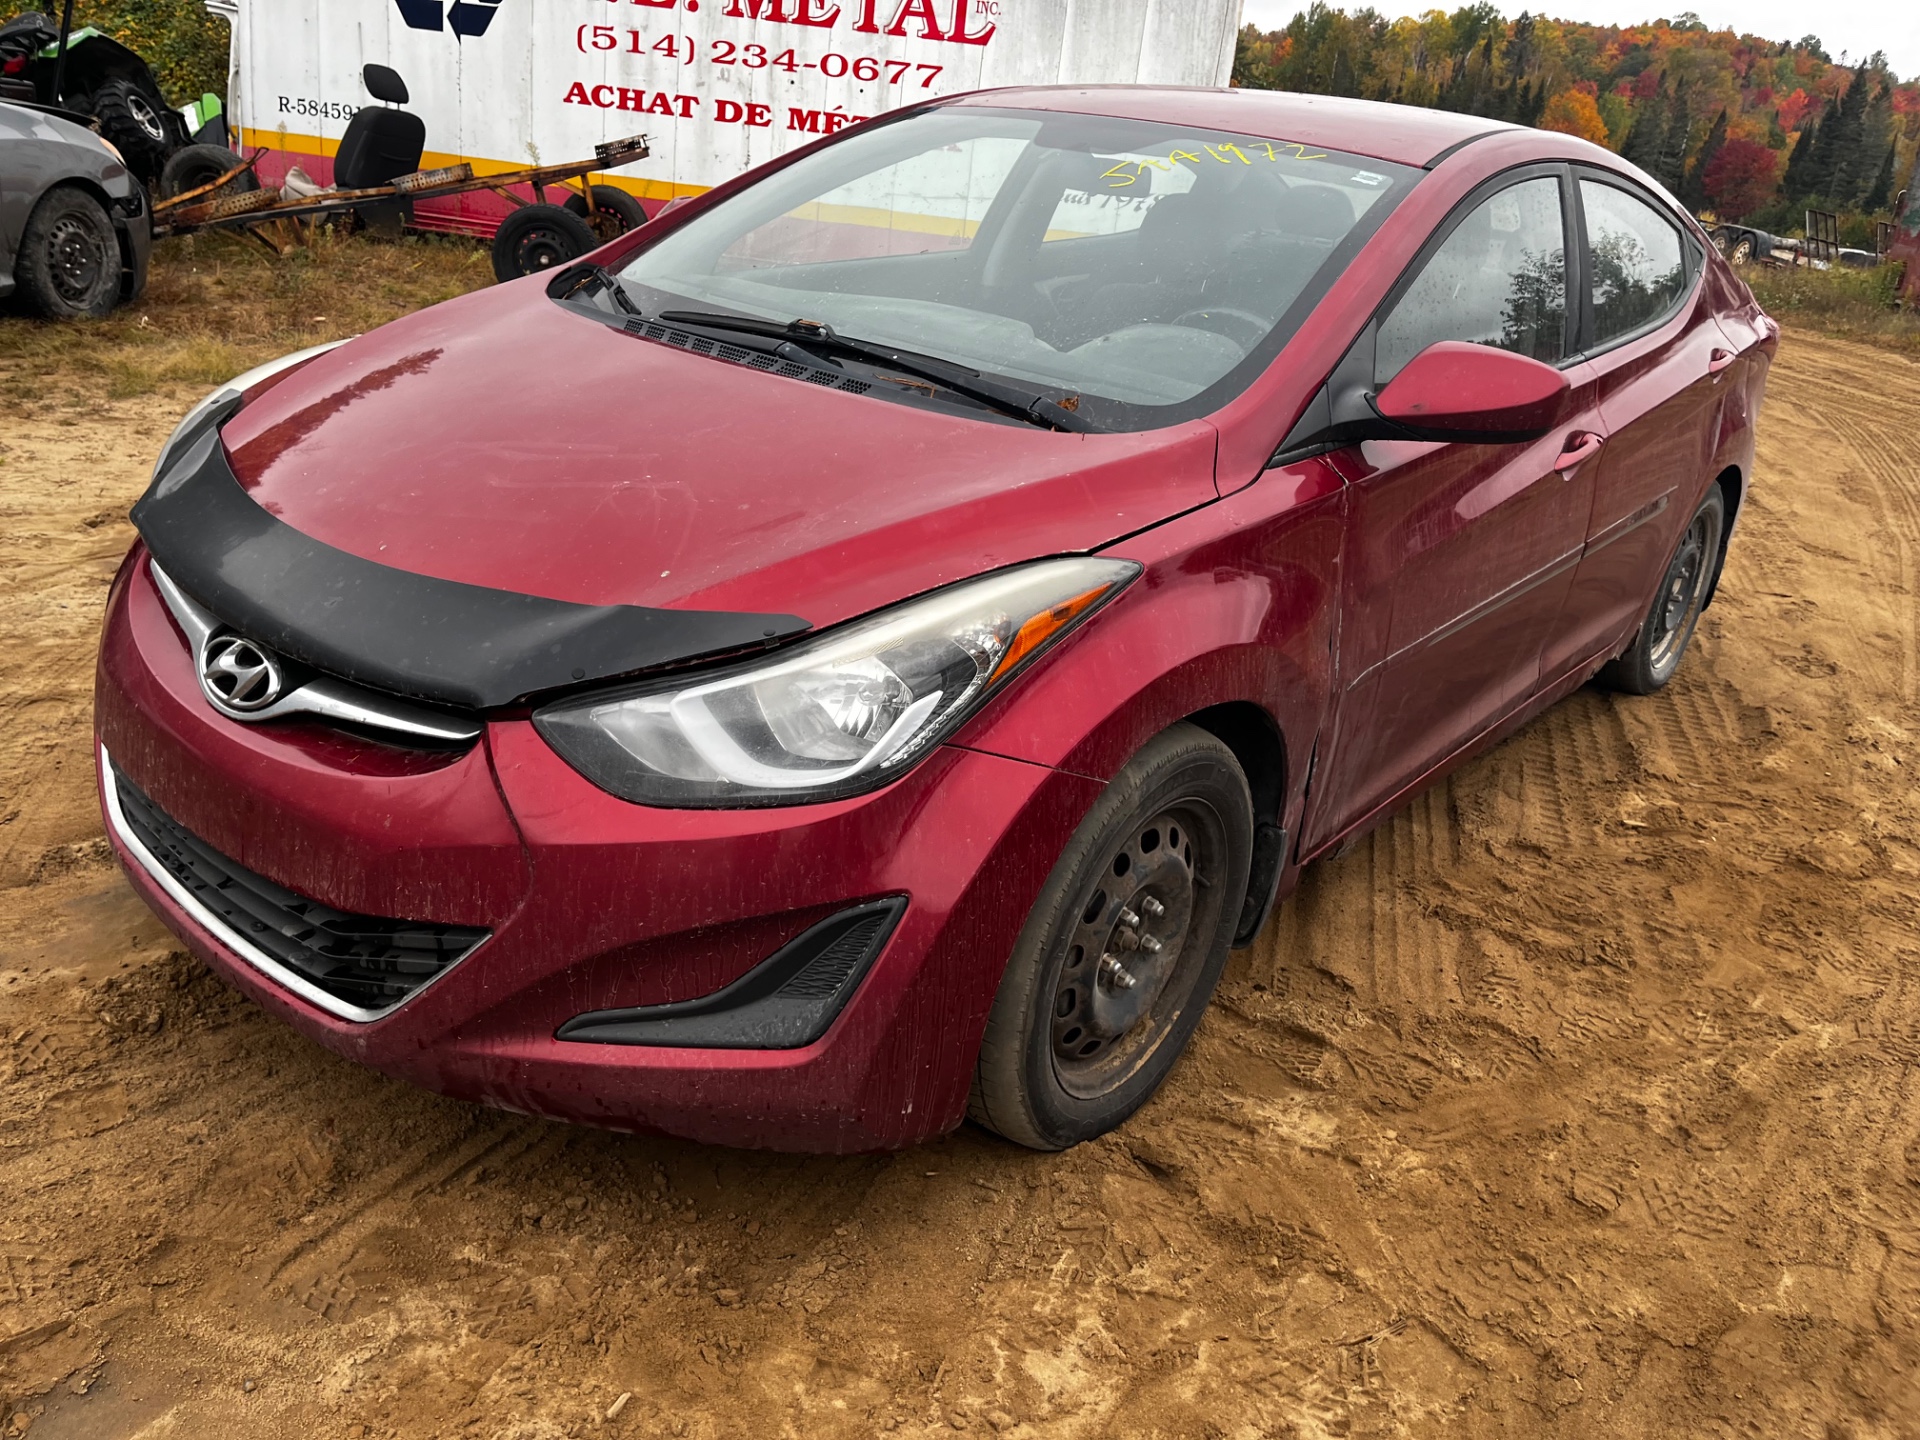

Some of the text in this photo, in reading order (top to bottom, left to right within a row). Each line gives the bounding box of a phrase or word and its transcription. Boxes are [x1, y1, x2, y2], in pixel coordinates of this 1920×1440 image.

[976, 0, 1001, 15] INC.
[576, 24, 943, 88] (514) 234-0677
[564, 82, 700, 118] ACHAT
[714, 99, 772, 127] DE
